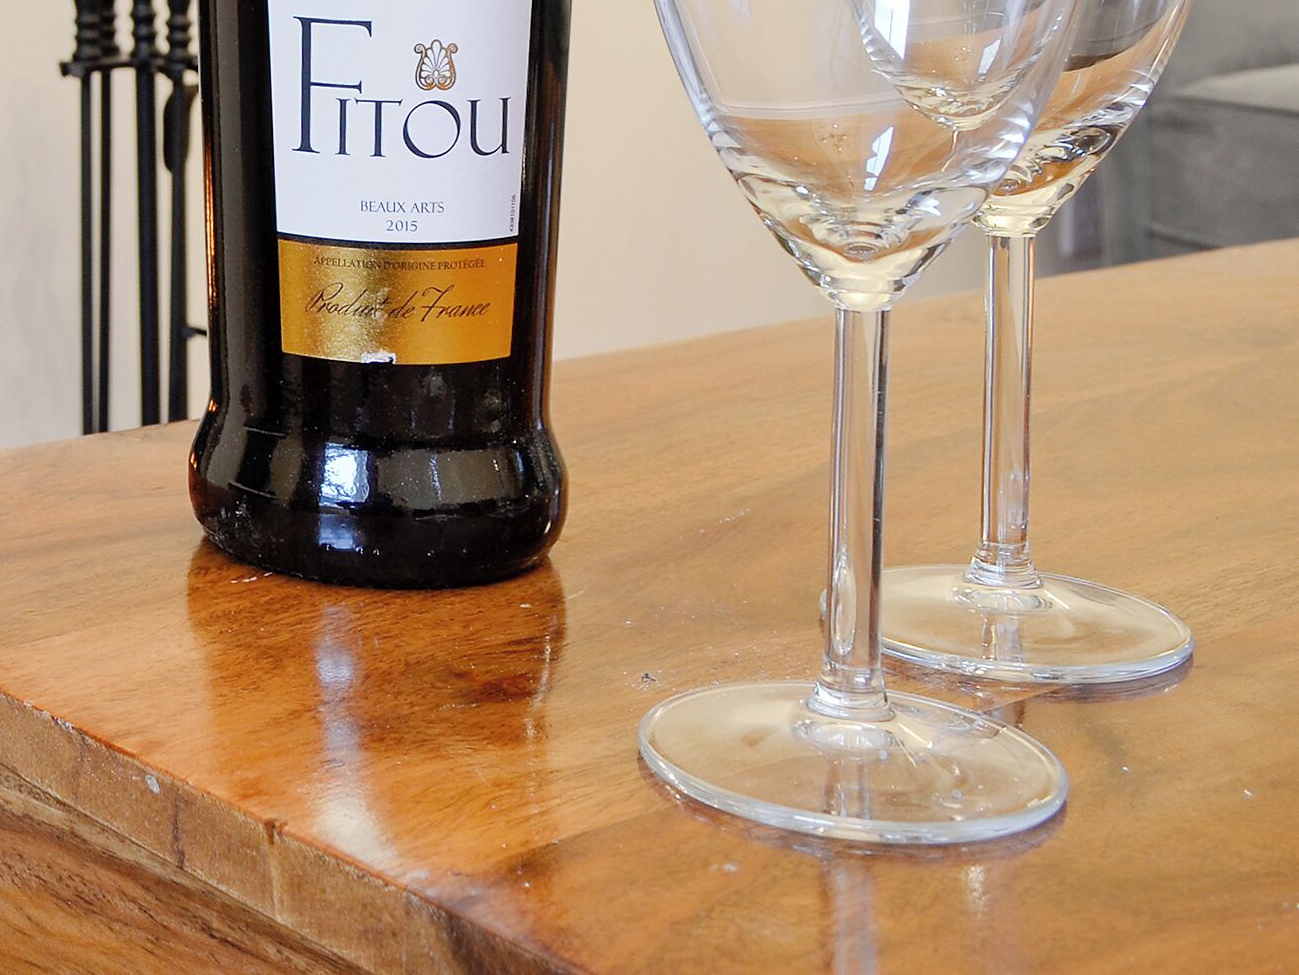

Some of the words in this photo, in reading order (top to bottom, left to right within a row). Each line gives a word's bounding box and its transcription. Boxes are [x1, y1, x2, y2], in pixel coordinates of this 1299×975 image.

[292, 16, 511, 158] FITOU
[360, 200, 406, 213] BEAUX
[410, 201, 445, 213] ARTS
[386, 220, 418, 232] 2015
[313, 257, 382, 270] APPELLATION
[383, 259, 435, 271] D'ORIGINE
[387, 291, 418, 319] de
[421, 284, 491, 323] France
